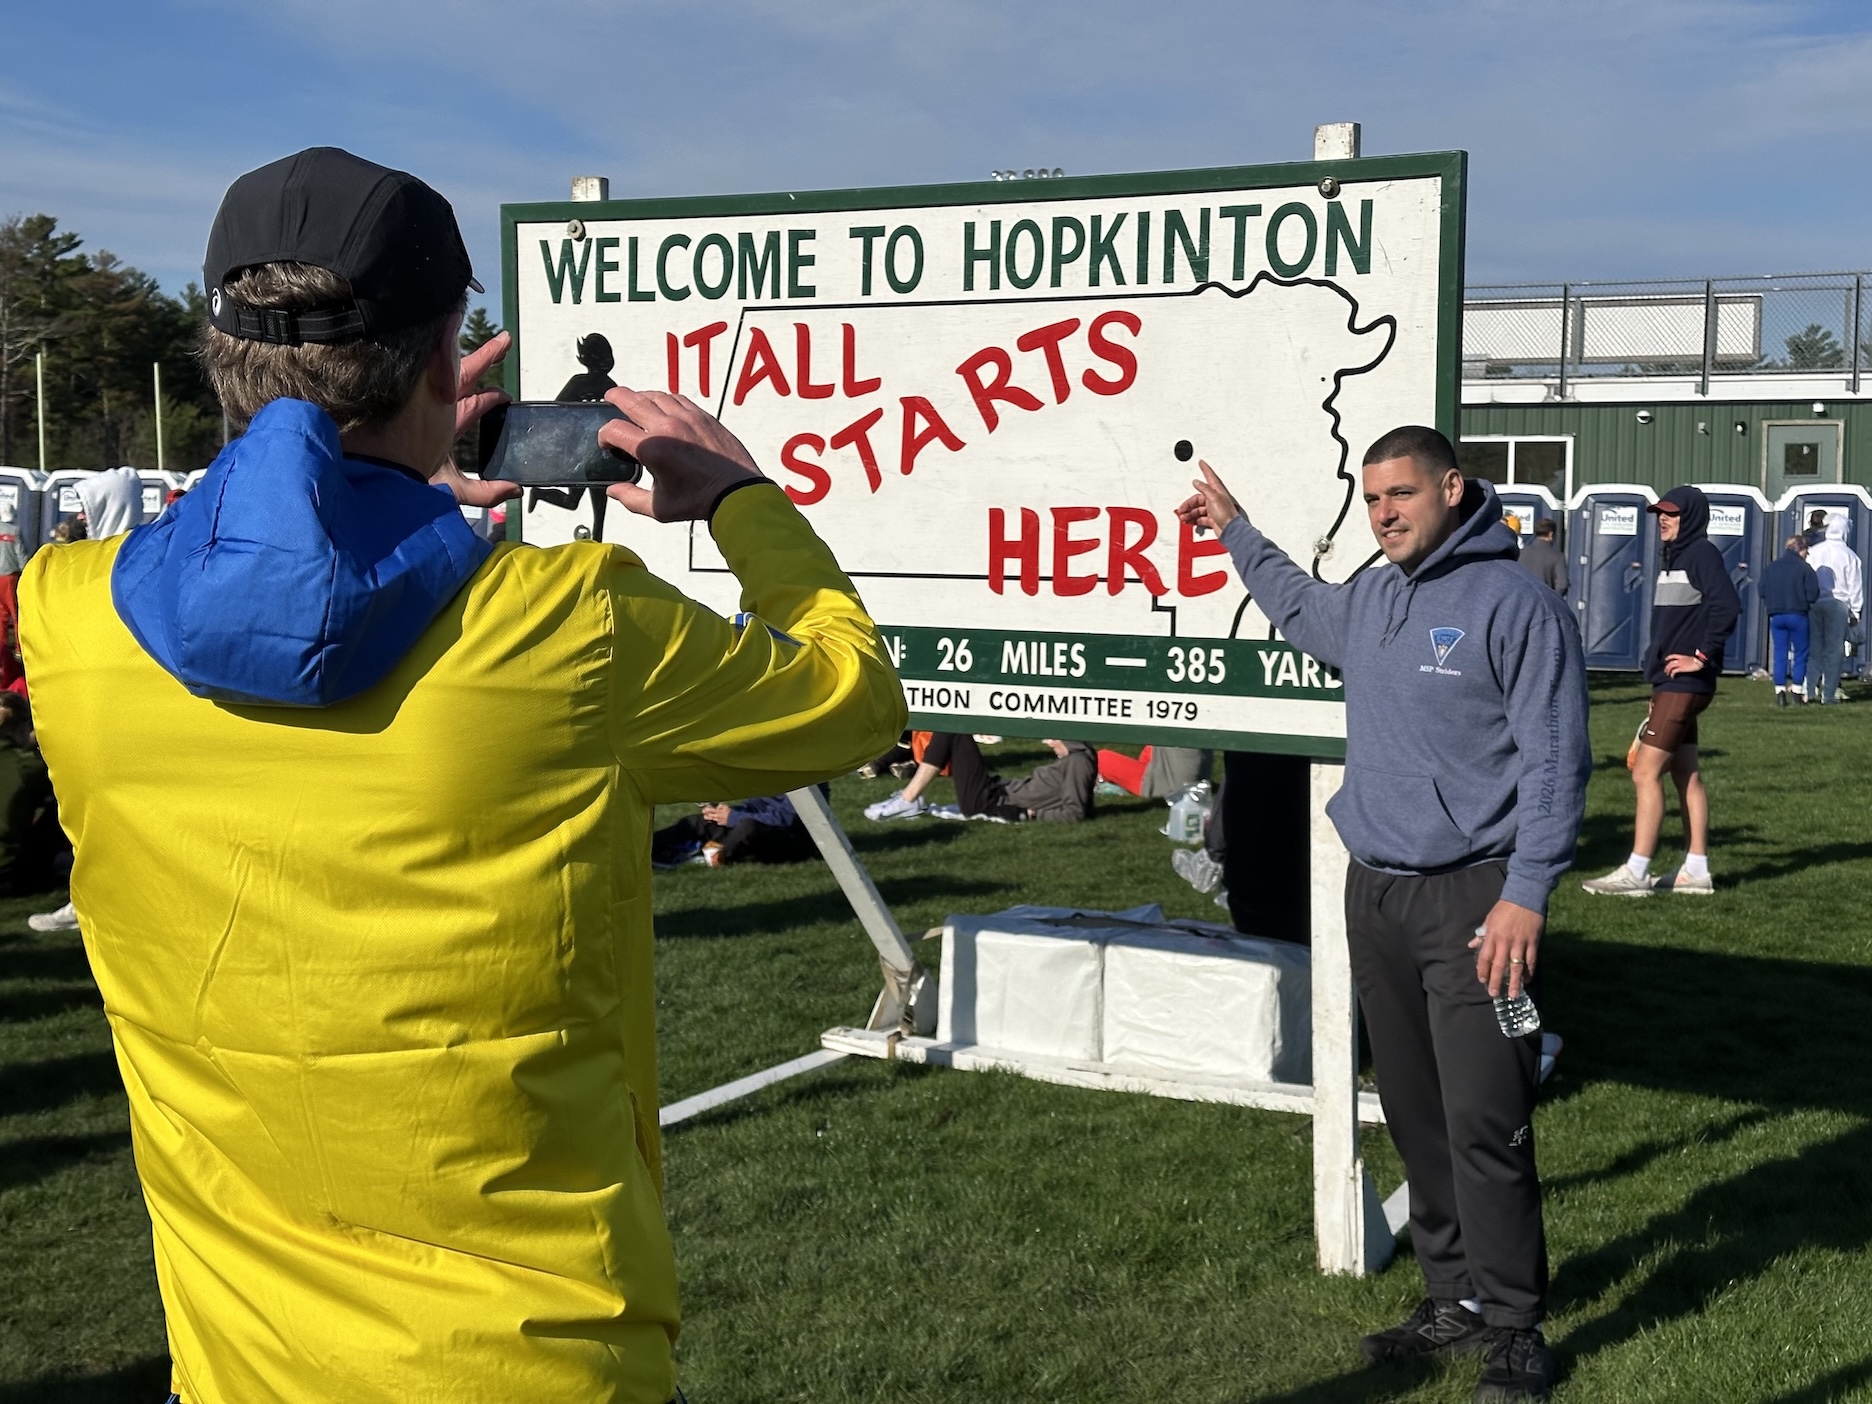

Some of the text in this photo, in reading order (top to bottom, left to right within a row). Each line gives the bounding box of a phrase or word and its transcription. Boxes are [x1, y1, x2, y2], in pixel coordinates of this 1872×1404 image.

[539, 198, 1374, 304] WELCOME TO HOPKINTON
[666, 320, 882, 406] IT ALL
[780, 310, 1142, 506] STARTS
[988, 506, 1230, 598] HERE
[906, 687, 1199, 721] THON COMMITTEE 1979
[936, 636, 973, 673] 26
[1000, 639, 1087, 678] MILES
[1166, 646, 1226, 685] 385
